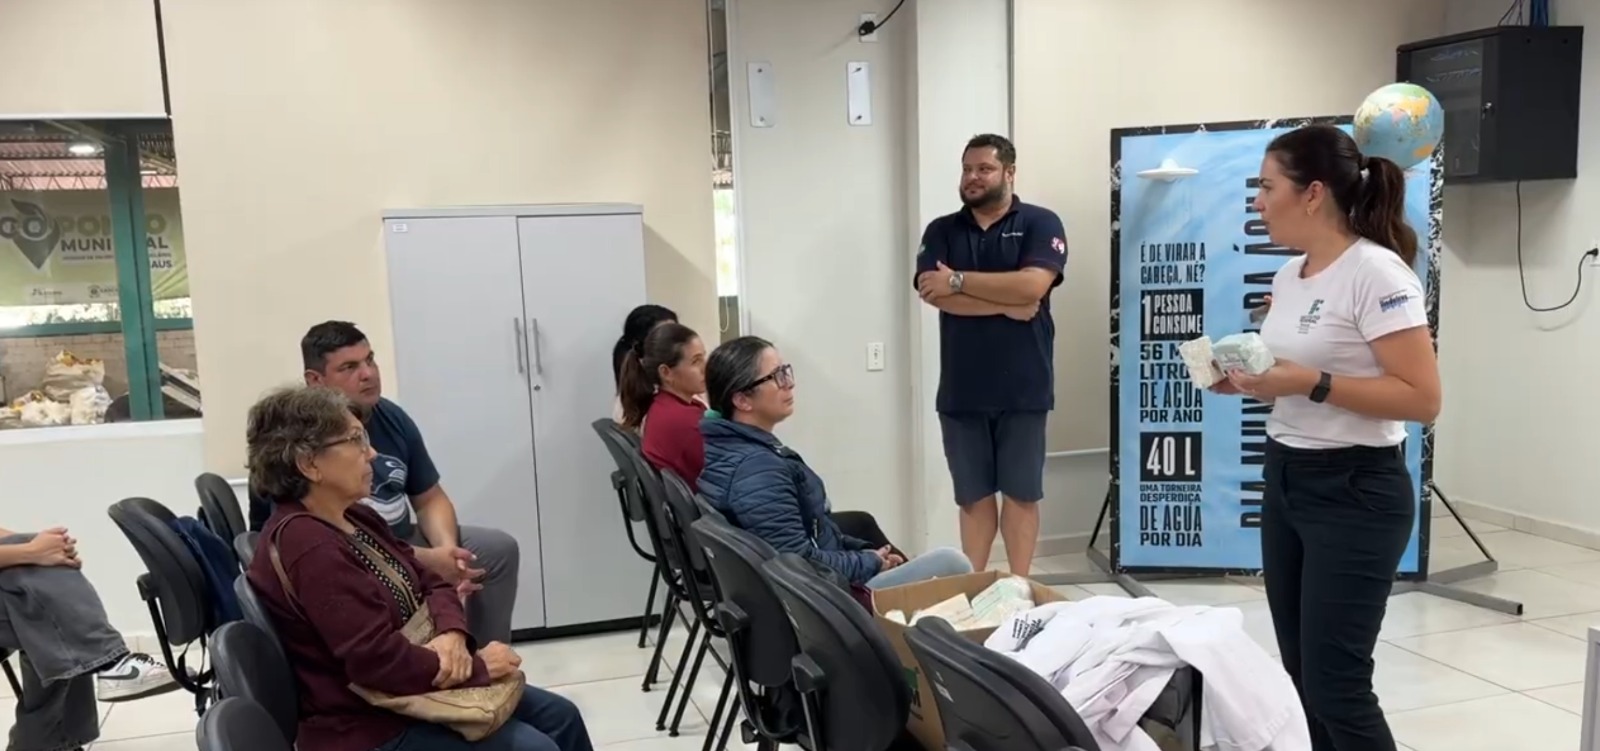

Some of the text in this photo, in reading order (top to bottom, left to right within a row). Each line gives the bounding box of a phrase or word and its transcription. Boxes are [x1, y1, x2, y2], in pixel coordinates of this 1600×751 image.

[61, 237, 168, 252] MUNIAL
[1141, 241, 1206, 262] É DE VIRAR A
[151, 260, 172, 268] AUS
[1141, 261, 1206, 285] CABEÇA, NÉ?
[1142, 293, 1193, 334] 1 PESSOA
[1153, 315, 1202, 334] CONSOME
[1140, 343, 1163, 360] 56
[1140, 363, 1191, 380] LITRO
[1140, 382, 1158, 408] DE
[1140, 409, 1203, 423] POR ANO
[1146, 436, 1195, 476] 40 L
[1140, 484, 1202, 492] UMA TORNEIRA
[1140, 505, 1158, 531] DE
[1140, 532, 1203, 547] POR DIA
